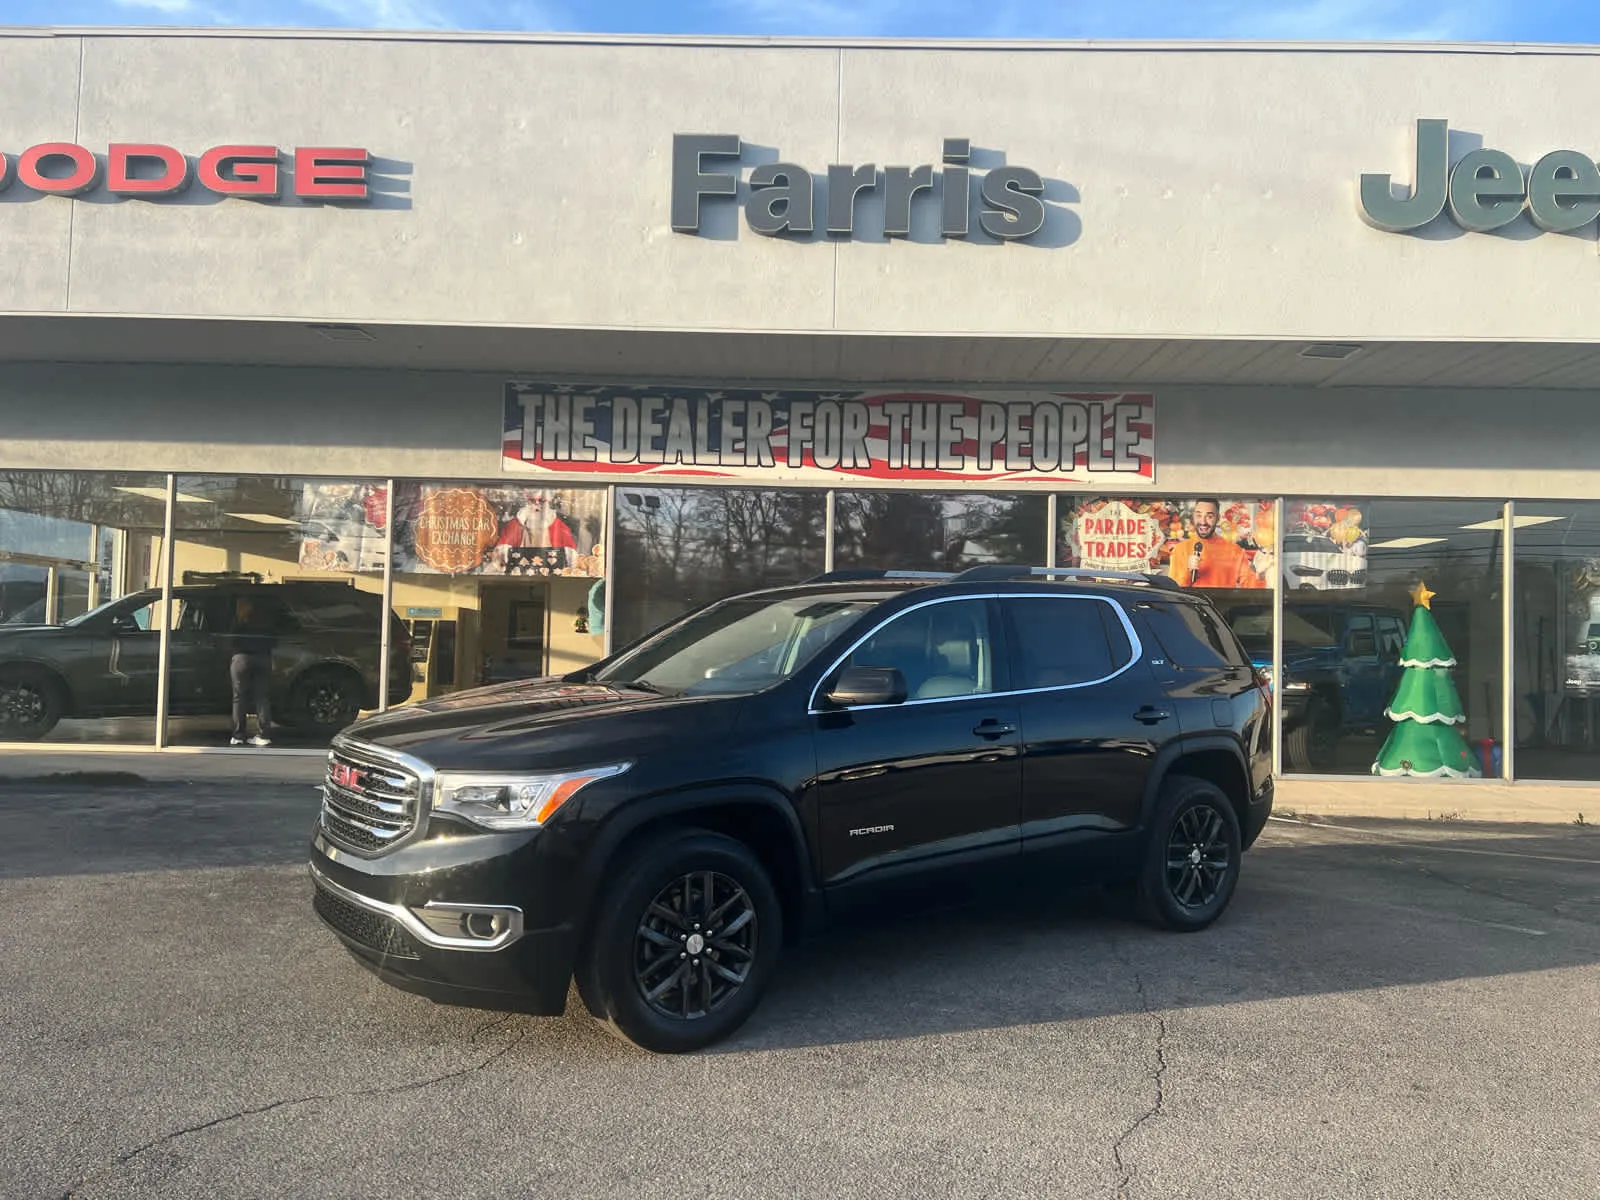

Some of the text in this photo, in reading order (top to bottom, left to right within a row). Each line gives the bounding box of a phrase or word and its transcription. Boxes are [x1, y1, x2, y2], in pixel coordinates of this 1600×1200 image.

[0, 142, 370, 197] ODGE
[1359, 118, 1600, 235] Jee
[671, 133, 1046, 240] Farris
[516, 392, 1141, 473] THE DEALER FOR THE PEOPLE
[419, 515, 490, 531] CHRISTMAS CAR
[1084, 518, 1146, 535] PARADE
[431, 531, 478, 546] EXCHANGE
[1083, 541, 1147, 559] TRADES
[849, 824, 895, 837] ACADIA
